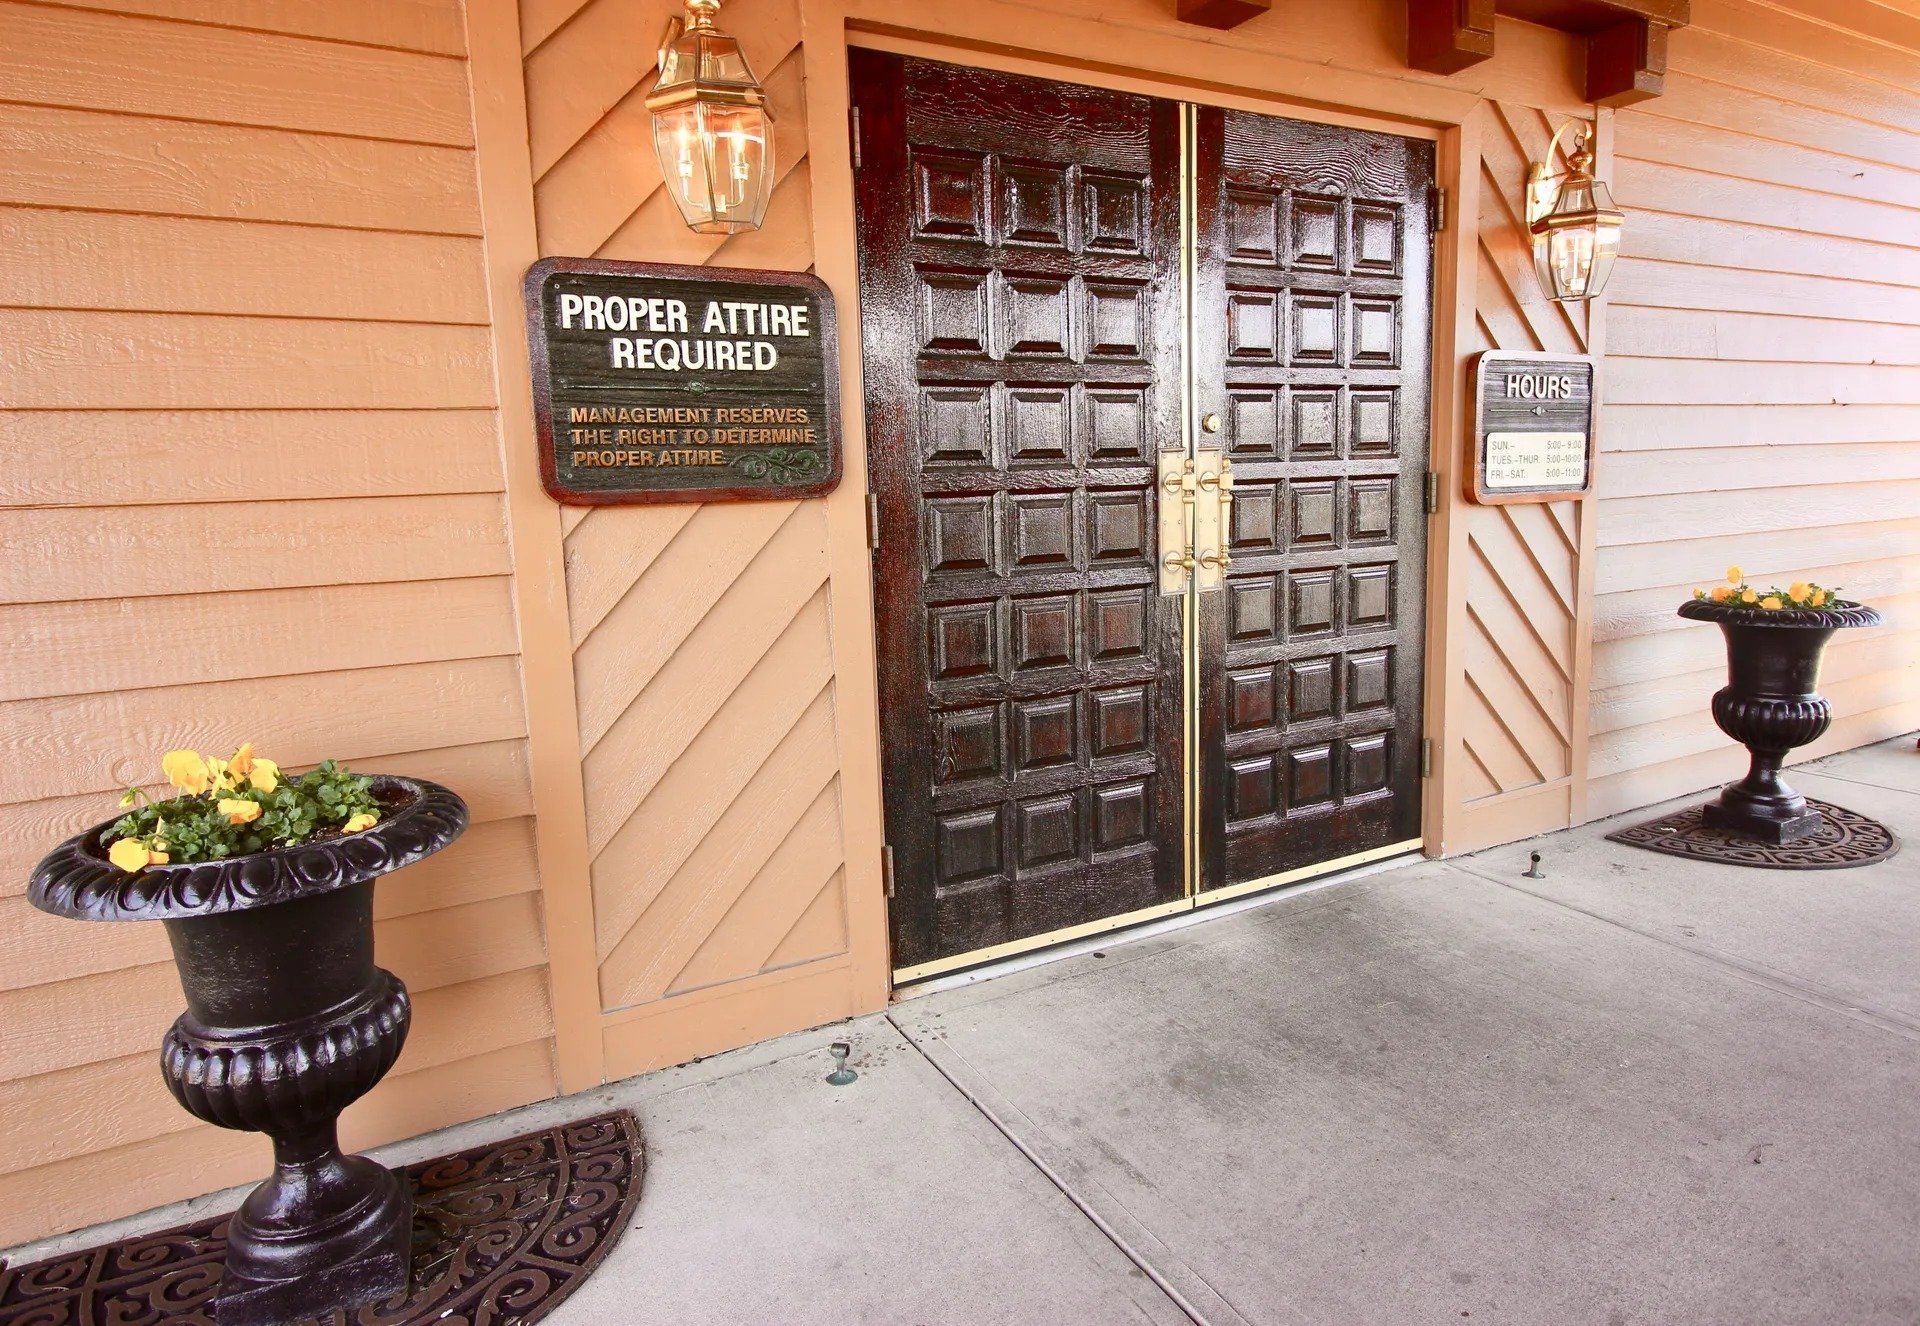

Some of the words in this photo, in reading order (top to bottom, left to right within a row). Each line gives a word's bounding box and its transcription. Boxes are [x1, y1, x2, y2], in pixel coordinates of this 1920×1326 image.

[561, 293, 688, 333] PROPER
[703, 301, 809, 337] ATTIRE
[612, 338, 778, 372] REQUIRED
[1507, 374, 1572, 399] HOURS
[571, 407, 711, 424] MANAGEMENT
[717, 408, 808, 424] RESERVES
[571, 428, 612, 445] THE
[618, 429, 678, 445] RIGHT
[683, 429, 708, 444] TO
[715, 429, 815, 444] DETERMINE
[574, 450, 652, 467] PROPER
